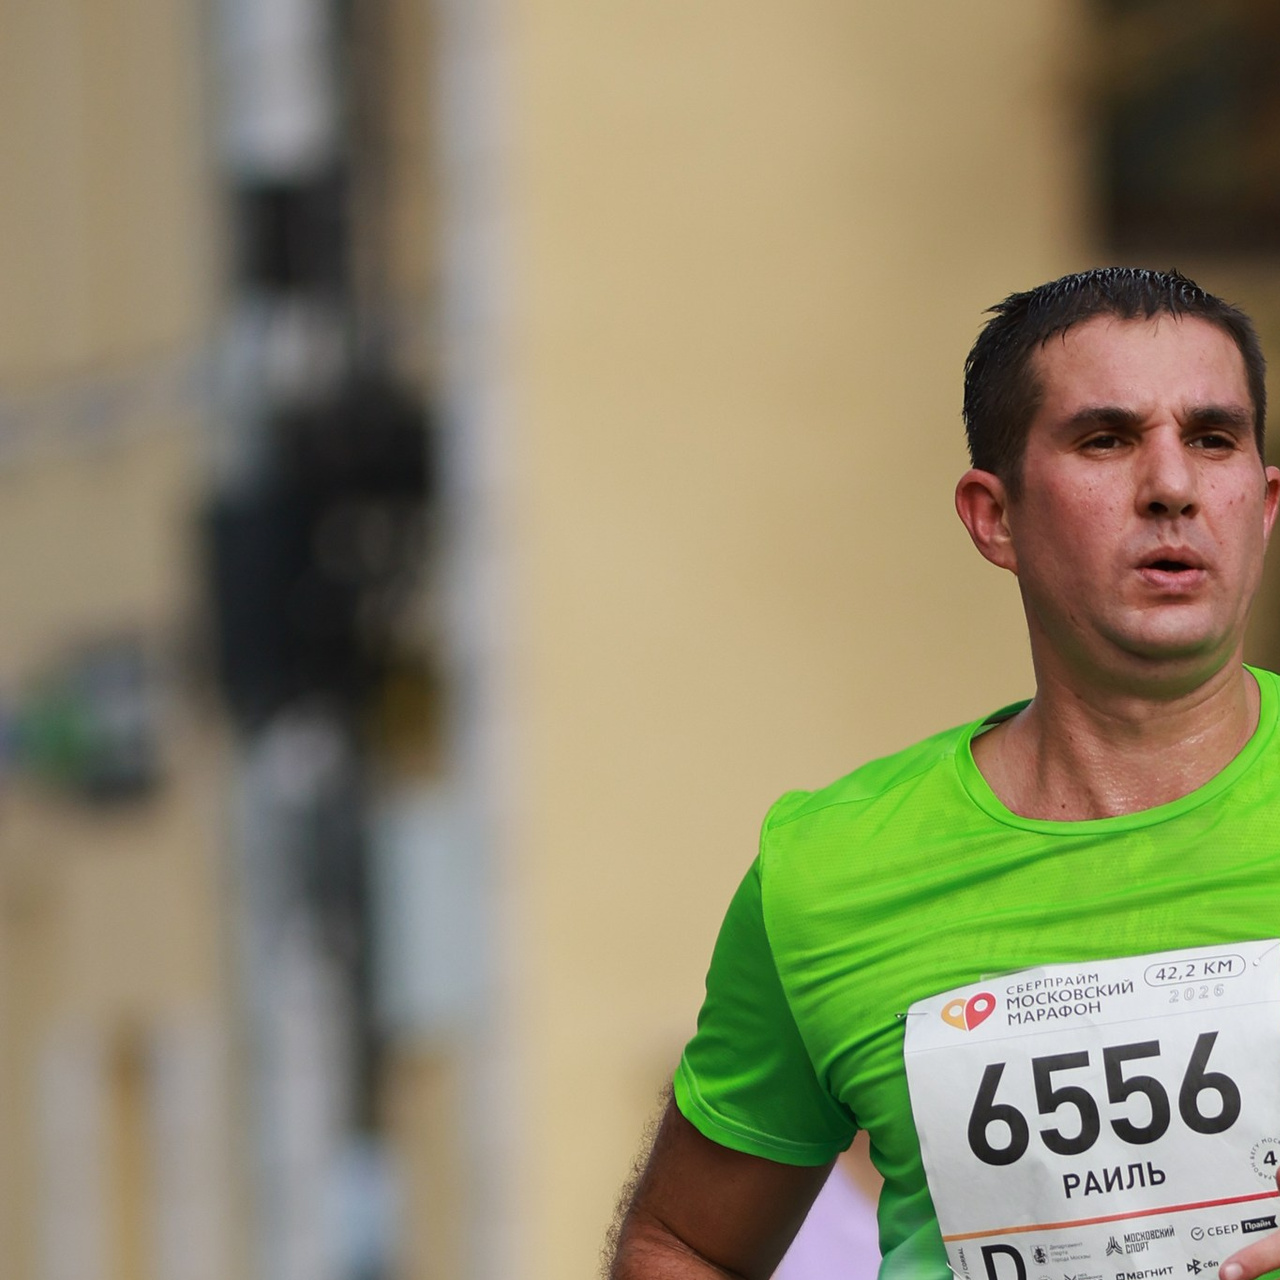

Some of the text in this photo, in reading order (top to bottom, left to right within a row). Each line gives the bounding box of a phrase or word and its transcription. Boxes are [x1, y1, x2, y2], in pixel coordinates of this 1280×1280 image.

[1156, 964, 1195, 981] 42,2
[1006, 973, 1099, 995] СБЕРПРАЙМ
[1169, 984, 1224, 1003] 2026
[1006, 979, 1134, 1010] МОСКОВСКИЙ
[1007, 1001, 1102, 1026] МАРАФОН
[968, 1031, 1242, 1167] 6556
[1263, 1150, 1278, 1166] 4
[1062, 1161, 1167, 1199] РАИЛЬ
[1124, 1225, 1175, 1243] МОСКОВСКИЙ
[1207, 1219, 1272, 1237] СБЕР Прайм
[1125, 1242, 1150, 1255] СПОРТ
